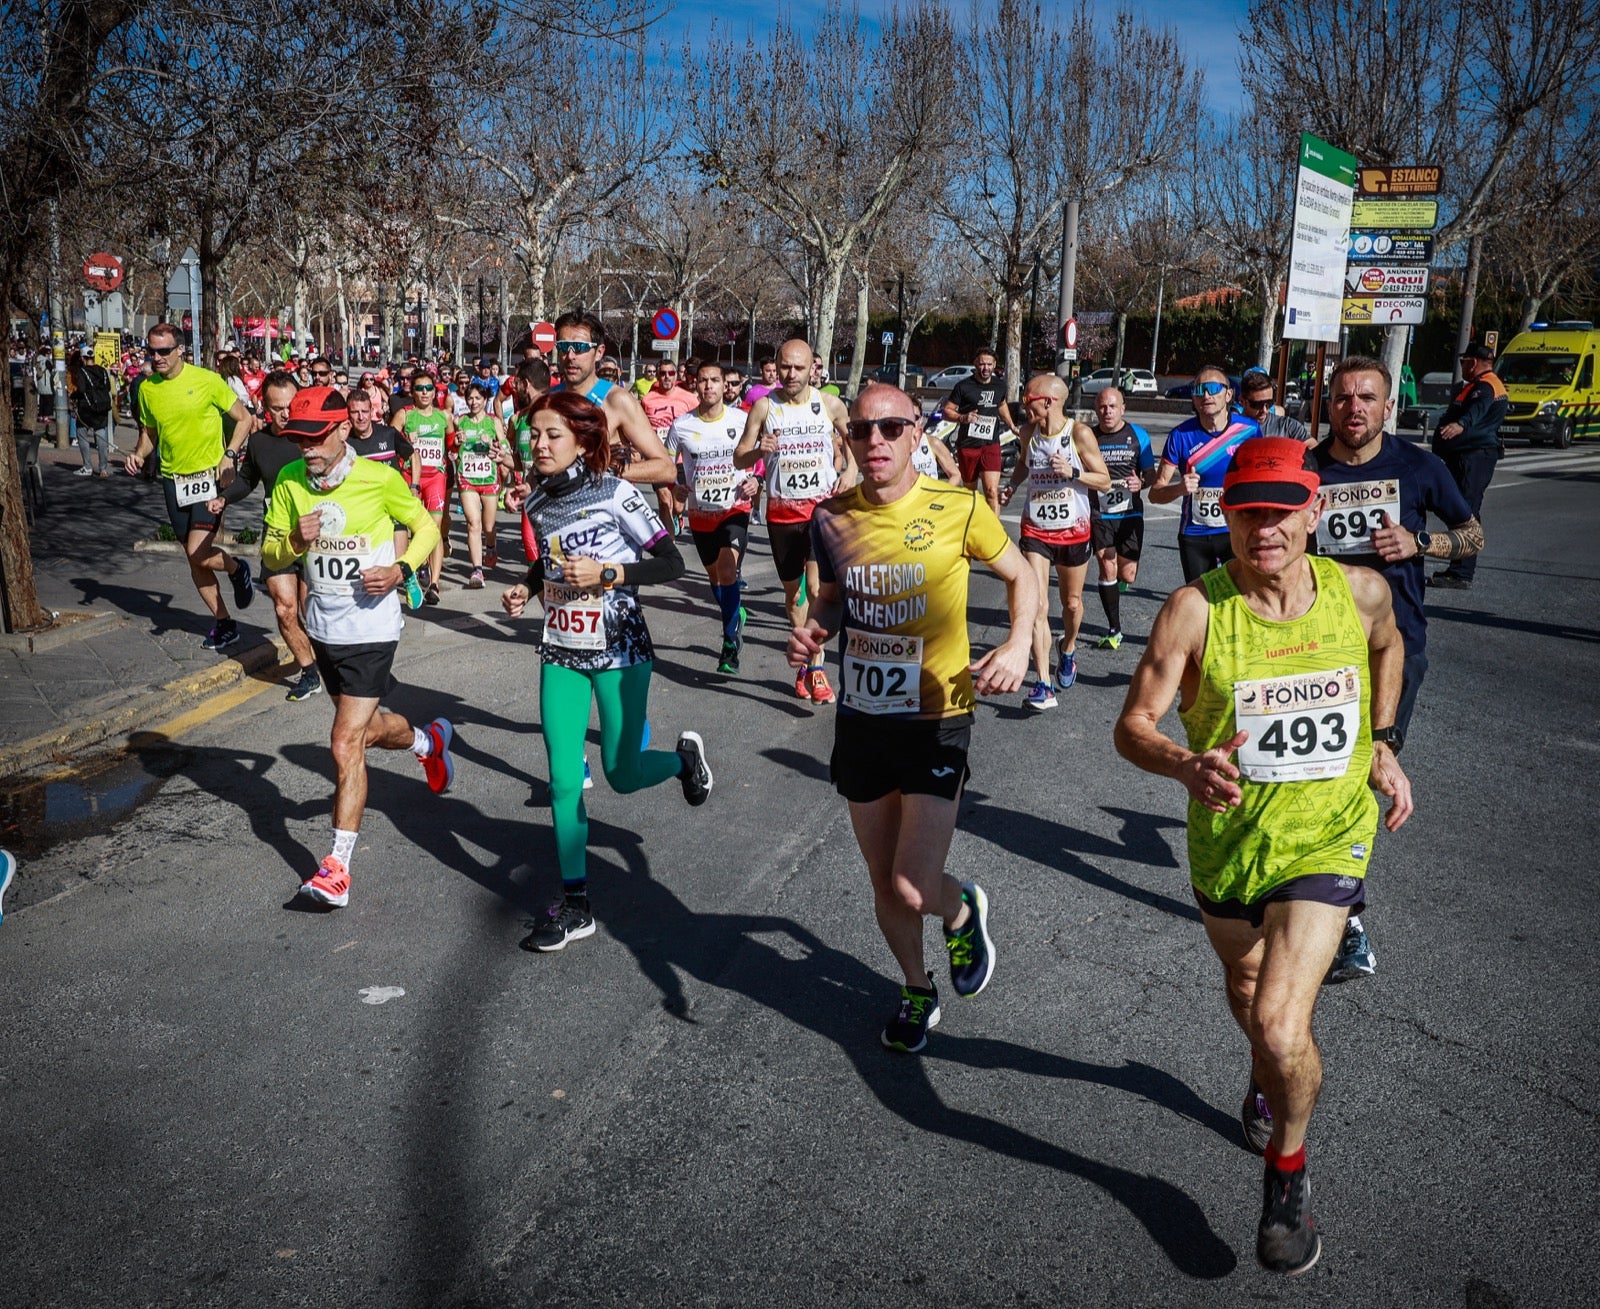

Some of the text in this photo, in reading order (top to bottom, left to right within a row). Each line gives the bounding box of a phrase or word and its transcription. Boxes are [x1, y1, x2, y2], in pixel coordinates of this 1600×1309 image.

[1391, 168, 1438, 182] ESTANCO
[1383, 300, 1422, 308] DECOPAQ
[975, 423, 991, 435] 786
[464, 462, 490, 473] 2145
[788, 460, 817, 469] FONDO
[703, 477, 728, 486] FONDO
[787, 472, 820, 489] 434
[183, 481, 210, 497] 189
[702, 487, 731, 502] 427
[1331, 487, 1382, 504] FONDO
[1037, 504, 1069, 520] 435
[904, 518, 935, 530] ATLETISMO
[1328, 509, 1386, 540] 693
[315, 540, 356, 550] FONDO
[314, 556, 361, 580] 102
[846, 563, 924, 596] ATLETISMO
[553, 587, 589, 601] FONDO
[547, 606, 601, 633] 2057
[858, 640, 904, 656] FONDO
[1266, 643, 1304, 659] luanvi
[852, 661, 907, 697] 702
[1266, 681, 1290, 690] GRAN
[1293, 676, 1326, 686] PREMIO
[1265, 681, 1340, 705] FONDO
[1258, 712, 1347, 758] 493
